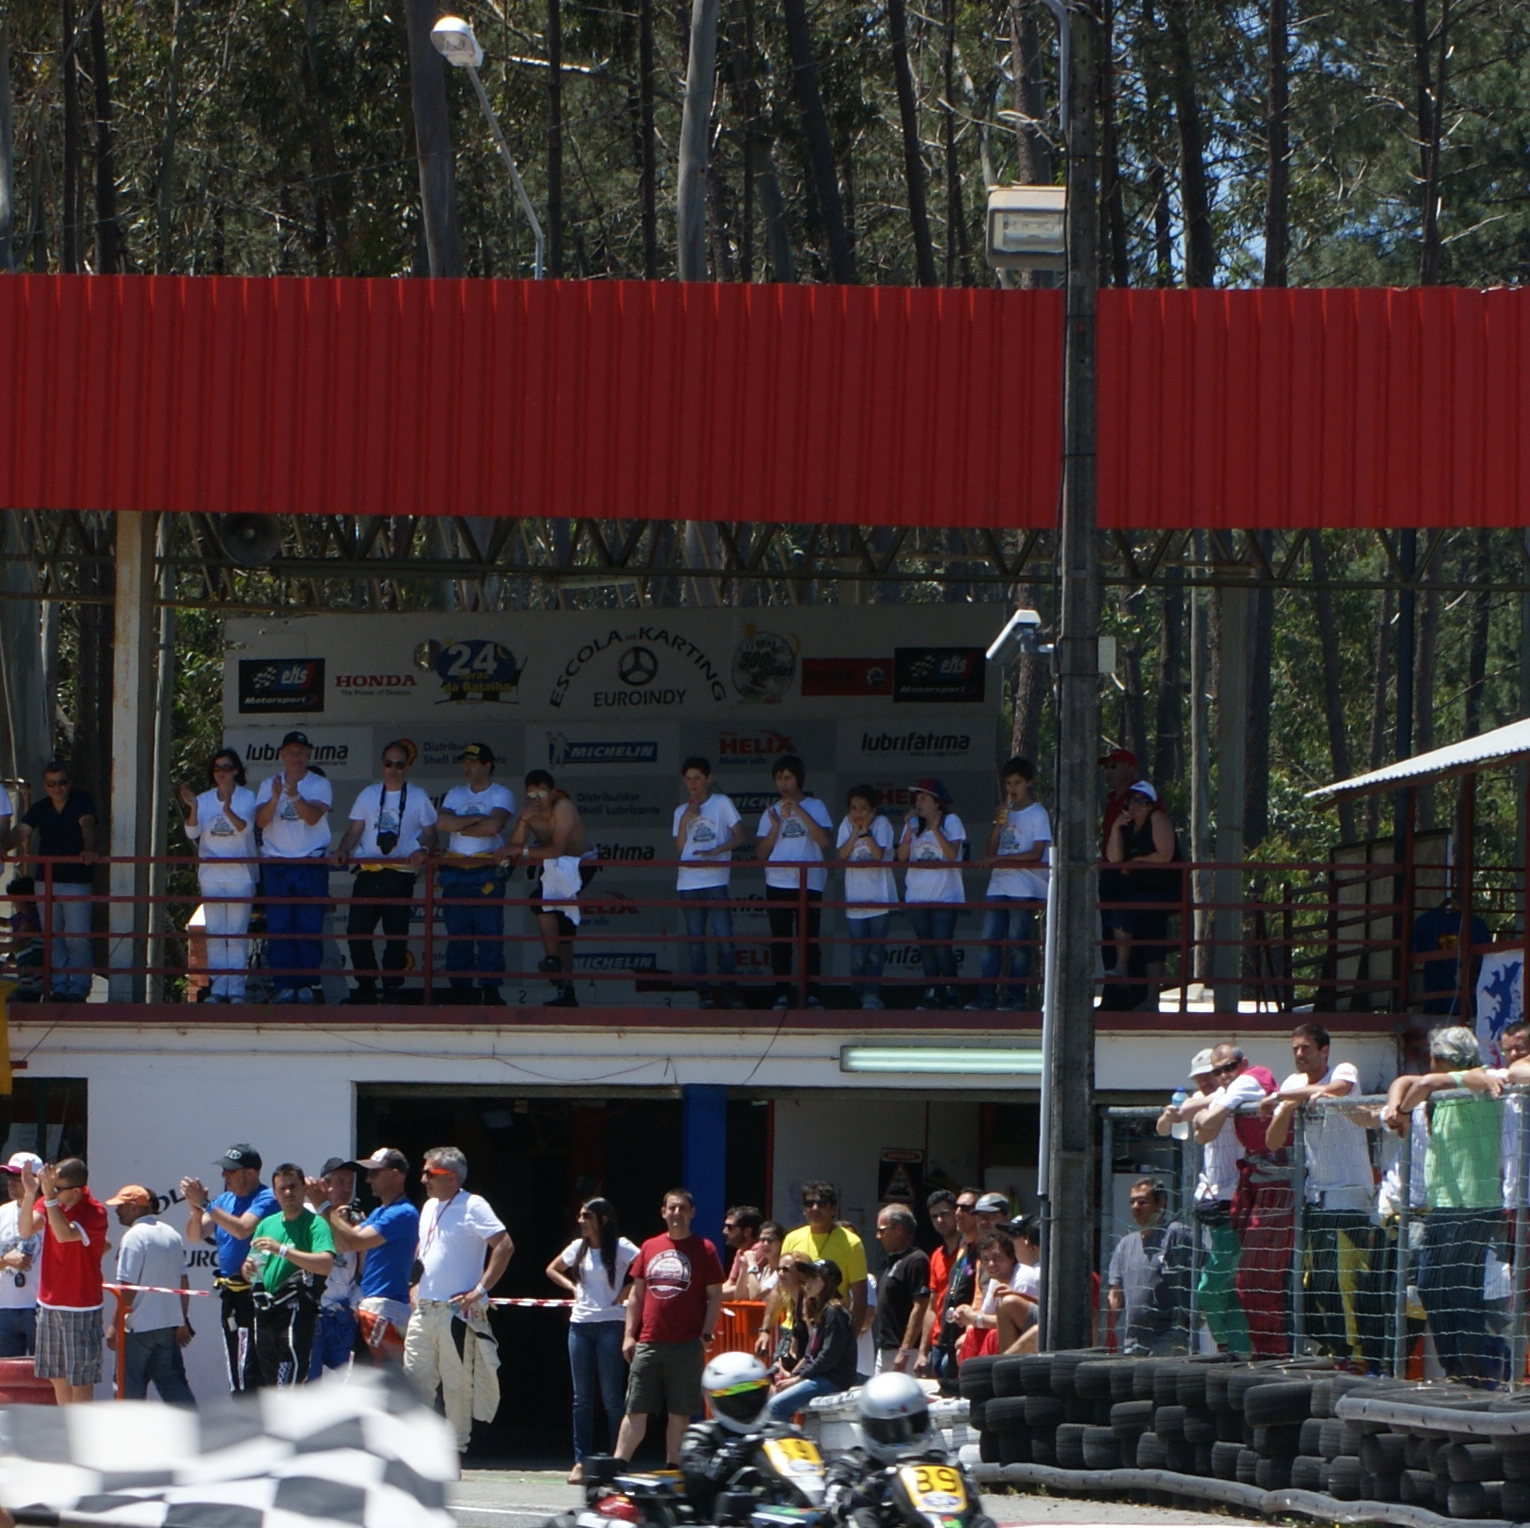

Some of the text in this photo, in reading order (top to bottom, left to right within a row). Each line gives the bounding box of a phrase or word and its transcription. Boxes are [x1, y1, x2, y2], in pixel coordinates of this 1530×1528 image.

[447, 643, 498, 676] 24
[550, 630, 622, 707] ESCOLA
[639, 627, 726, 702] KARTING
[335, 674, 418, 687] HONDA
[900, 685, 965, 694] Motorsport
[244, 695, 306, 705] Motorsport
[593, 689, 686, 707] EUROINDY
[246, 743, 349, 761] lubrima
[424, 741, 469, 752] Distribui
[569, 745, 655, 759] MICHELIN
[720, 737, 791, 755] HELIX
[424, 754, 449, 765] Shell
